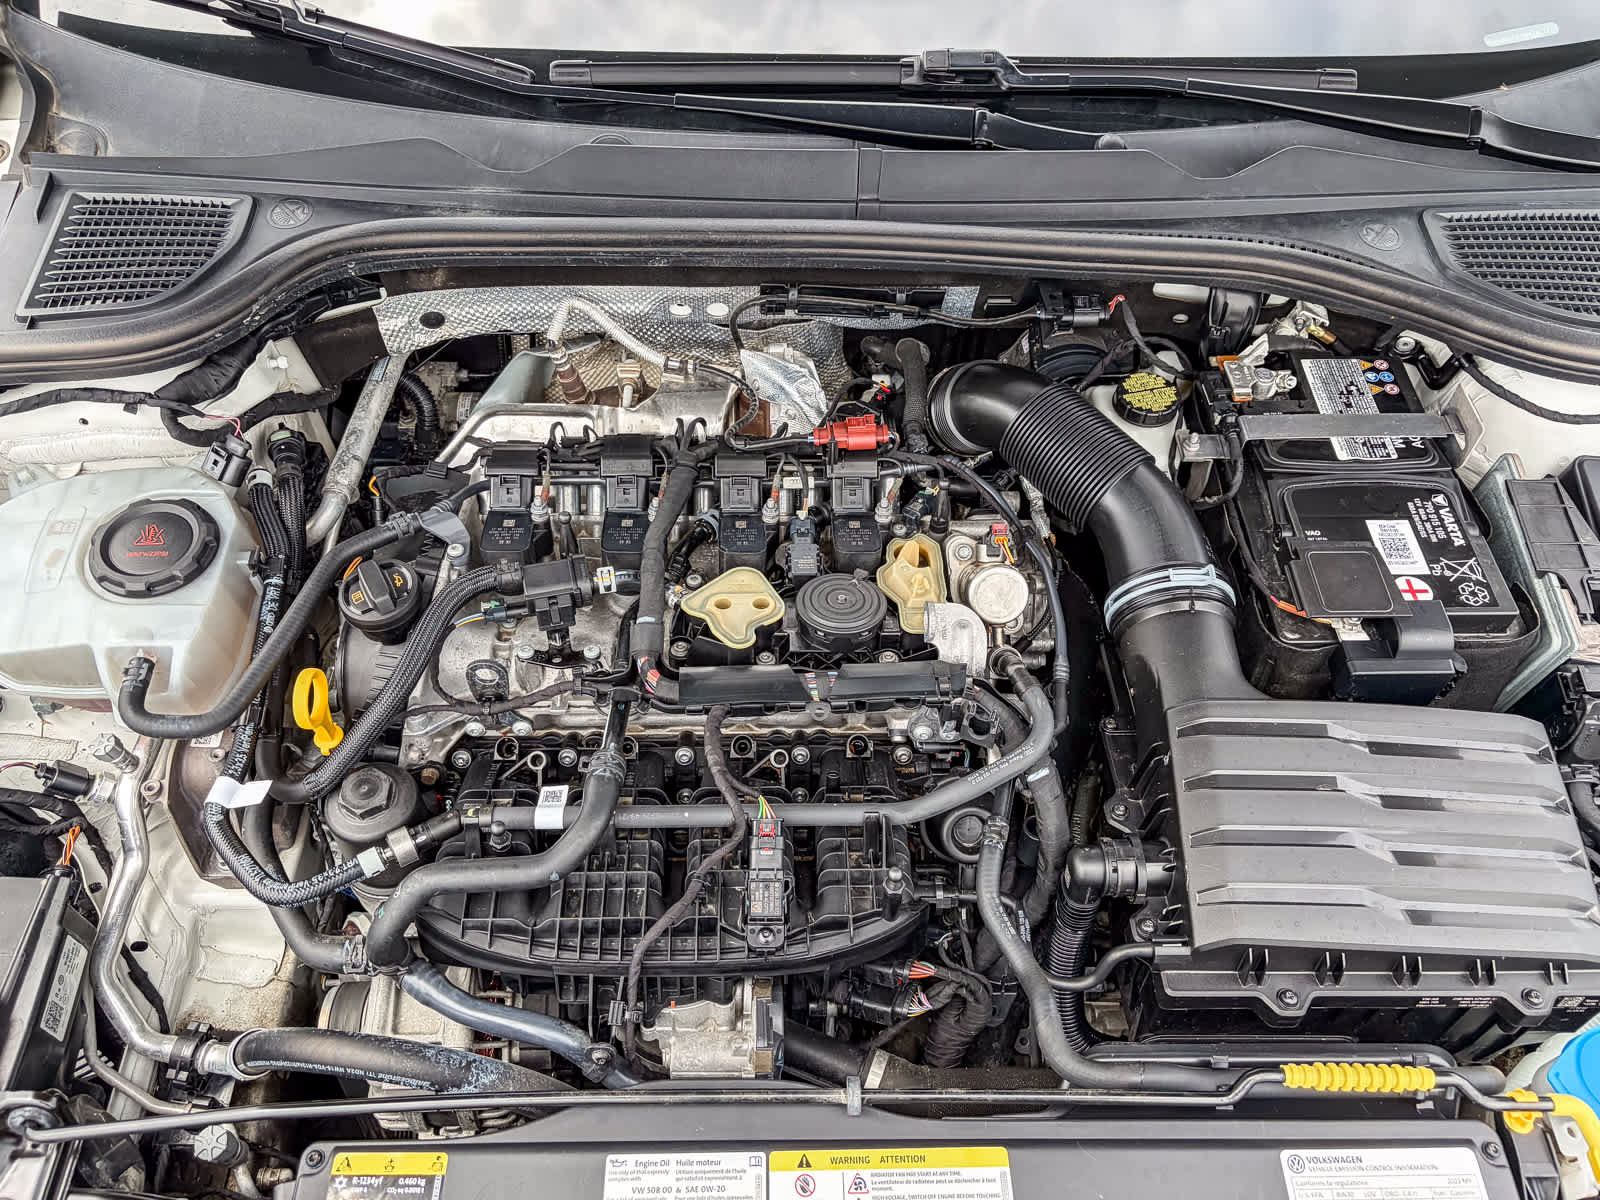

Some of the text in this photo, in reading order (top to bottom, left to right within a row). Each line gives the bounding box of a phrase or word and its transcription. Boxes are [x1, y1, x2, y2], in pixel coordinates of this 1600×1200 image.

[1428, 514, 1441, 526] 915
[1435, 527, 1447, 539] 105
[1439, 507, 1465, 546] VARTA
[1429, 564, 1442, 576] Pb
[634, 1159, 670, 1168] Engine Oil
[675, 1159, 721, 1167] Huile moteur
[830, 1154, 926, 1164] WARNING ATTENTION
[1305, 1155, 1363, 1164] VOLKSWAGEN
[631, 1186, 646, 1194] VW
[646, 1186, 661, 1194] 508
[662, 1186, 673, 1194] 00
[685, 1185, 698, 1193] SAE
[700, 1185, 726, 1193] 0W-20
